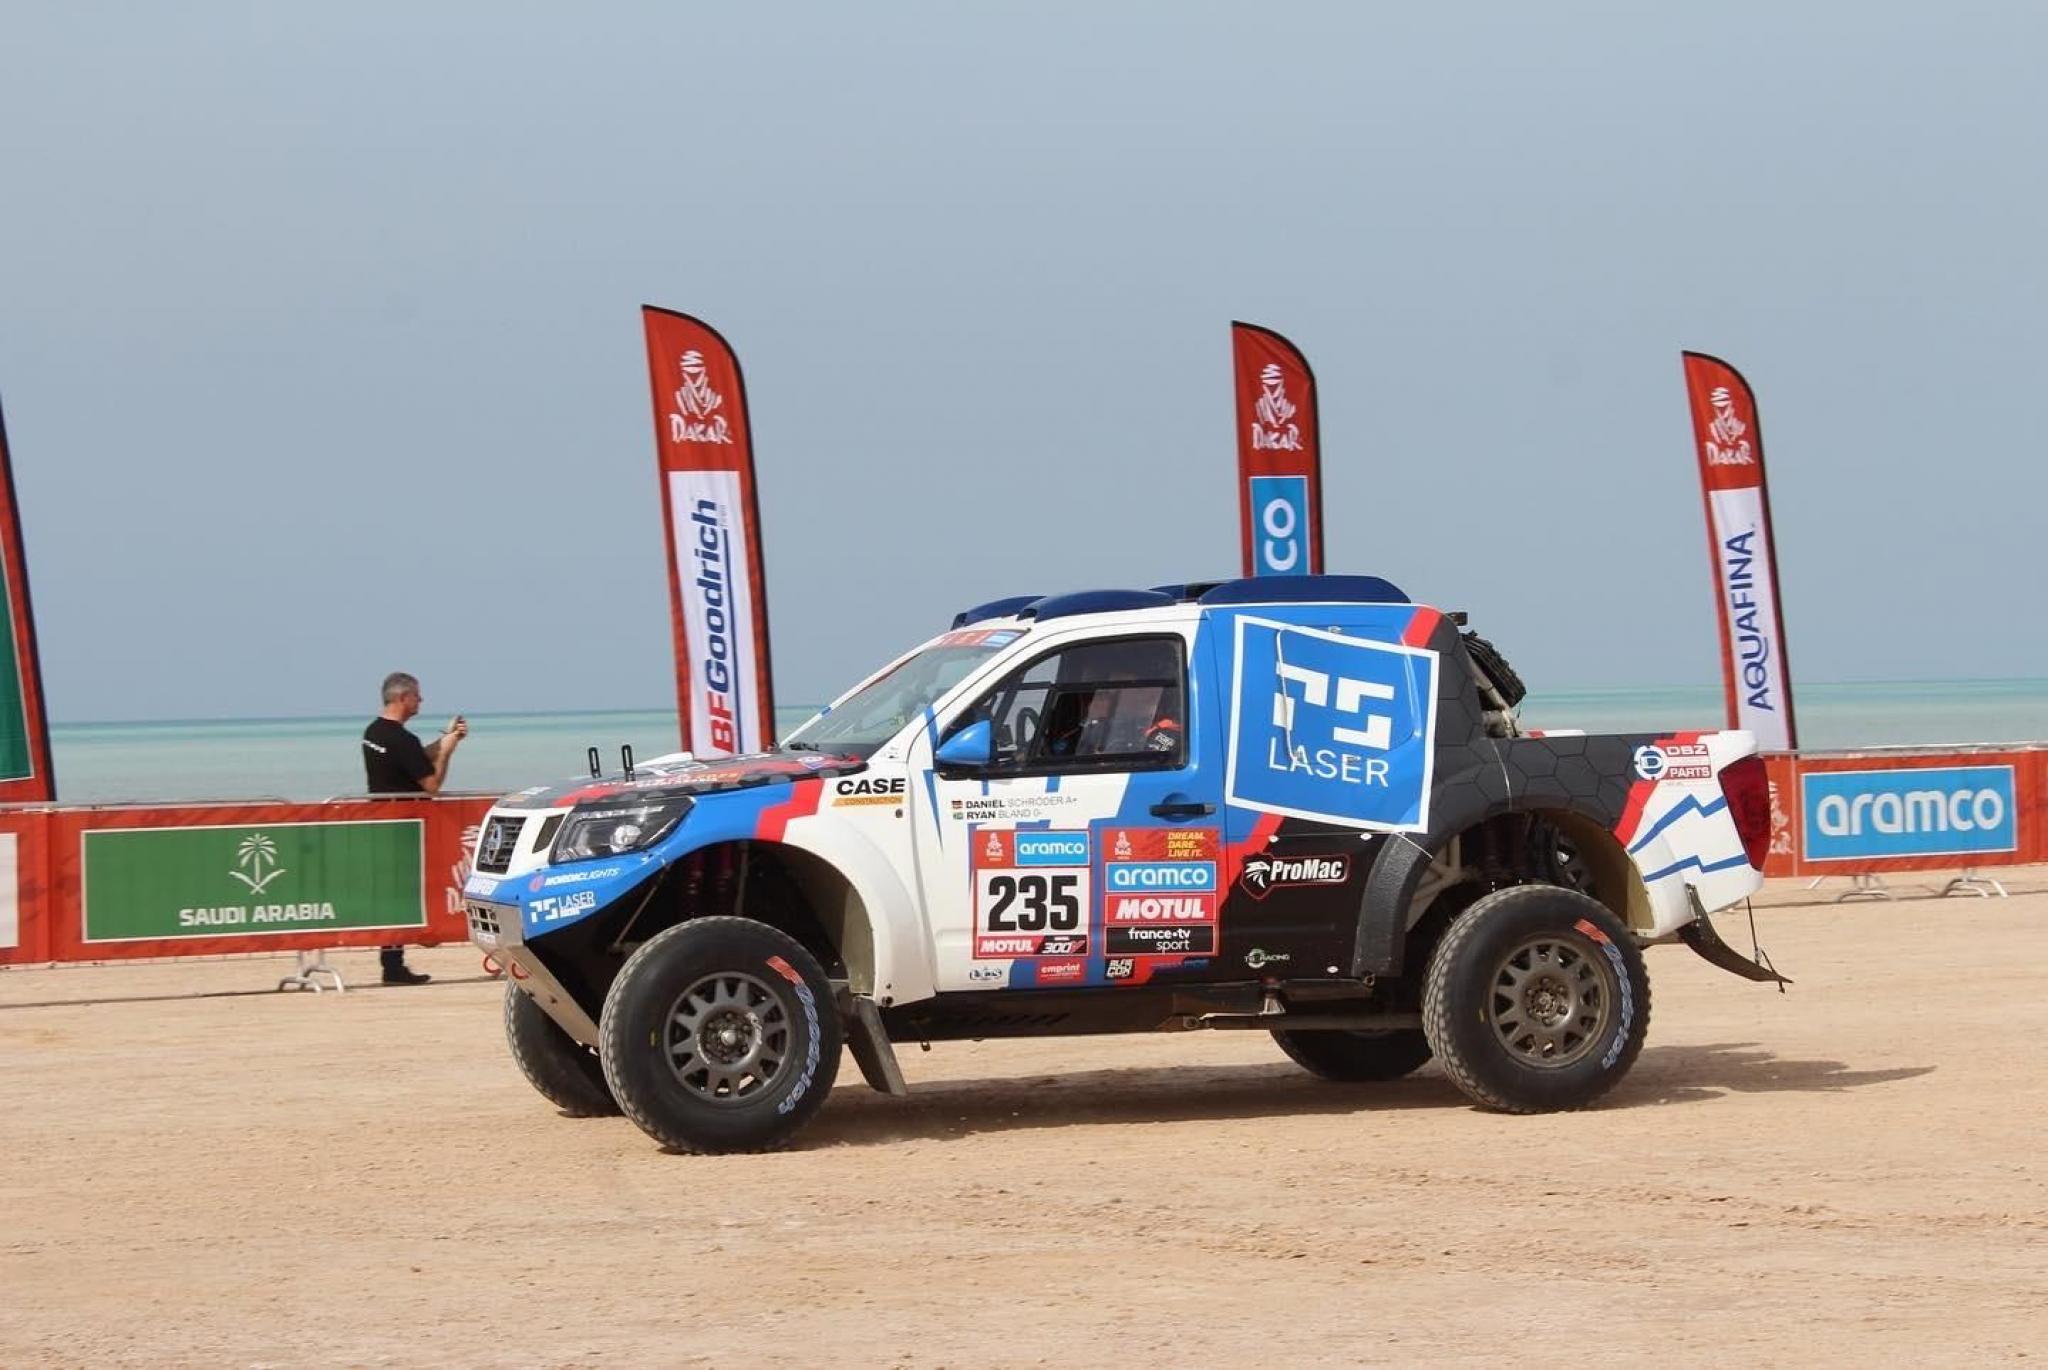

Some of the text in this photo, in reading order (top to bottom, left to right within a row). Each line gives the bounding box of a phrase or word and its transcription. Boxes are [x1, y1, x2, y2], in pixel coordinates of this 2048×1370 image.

[669, 413, 732, 444] DAKAR
[1252, 422, 1303, 451] DAKAR
[1706, 440, 1754, 466] DAKAR
[691, 499, 735, 755] BFGoodrich
[1726, 530, 1775, 712] AQUAFINA
[1666, 744, 1708, 756] DBZ
[1268, 736, 1389, 788] LASER
[1670, 766, 1710, 778] PARTS
[837, 777, 905, 795] CASE
[966, 800, 1005, 809] DANIEL
[966, 810, 996, 819] RYAN
[1817, 787, 2004, 836] aramco
[1020, 842, 1085, 855] aramco
[1114, 867, 1208, 886] aramco
[1270, 859, 1342, 880] ProMac
[559, 891, 595, 909] LASER
[988, 875, 1079, 932] 235
[1115, 898, 1206, 920] MOTUL
[180, 902, 336, 927] SAUDI ARABIA
[980, 939, 1034, 953] MOTUL
[1156, 939, 1190, 953] sport
